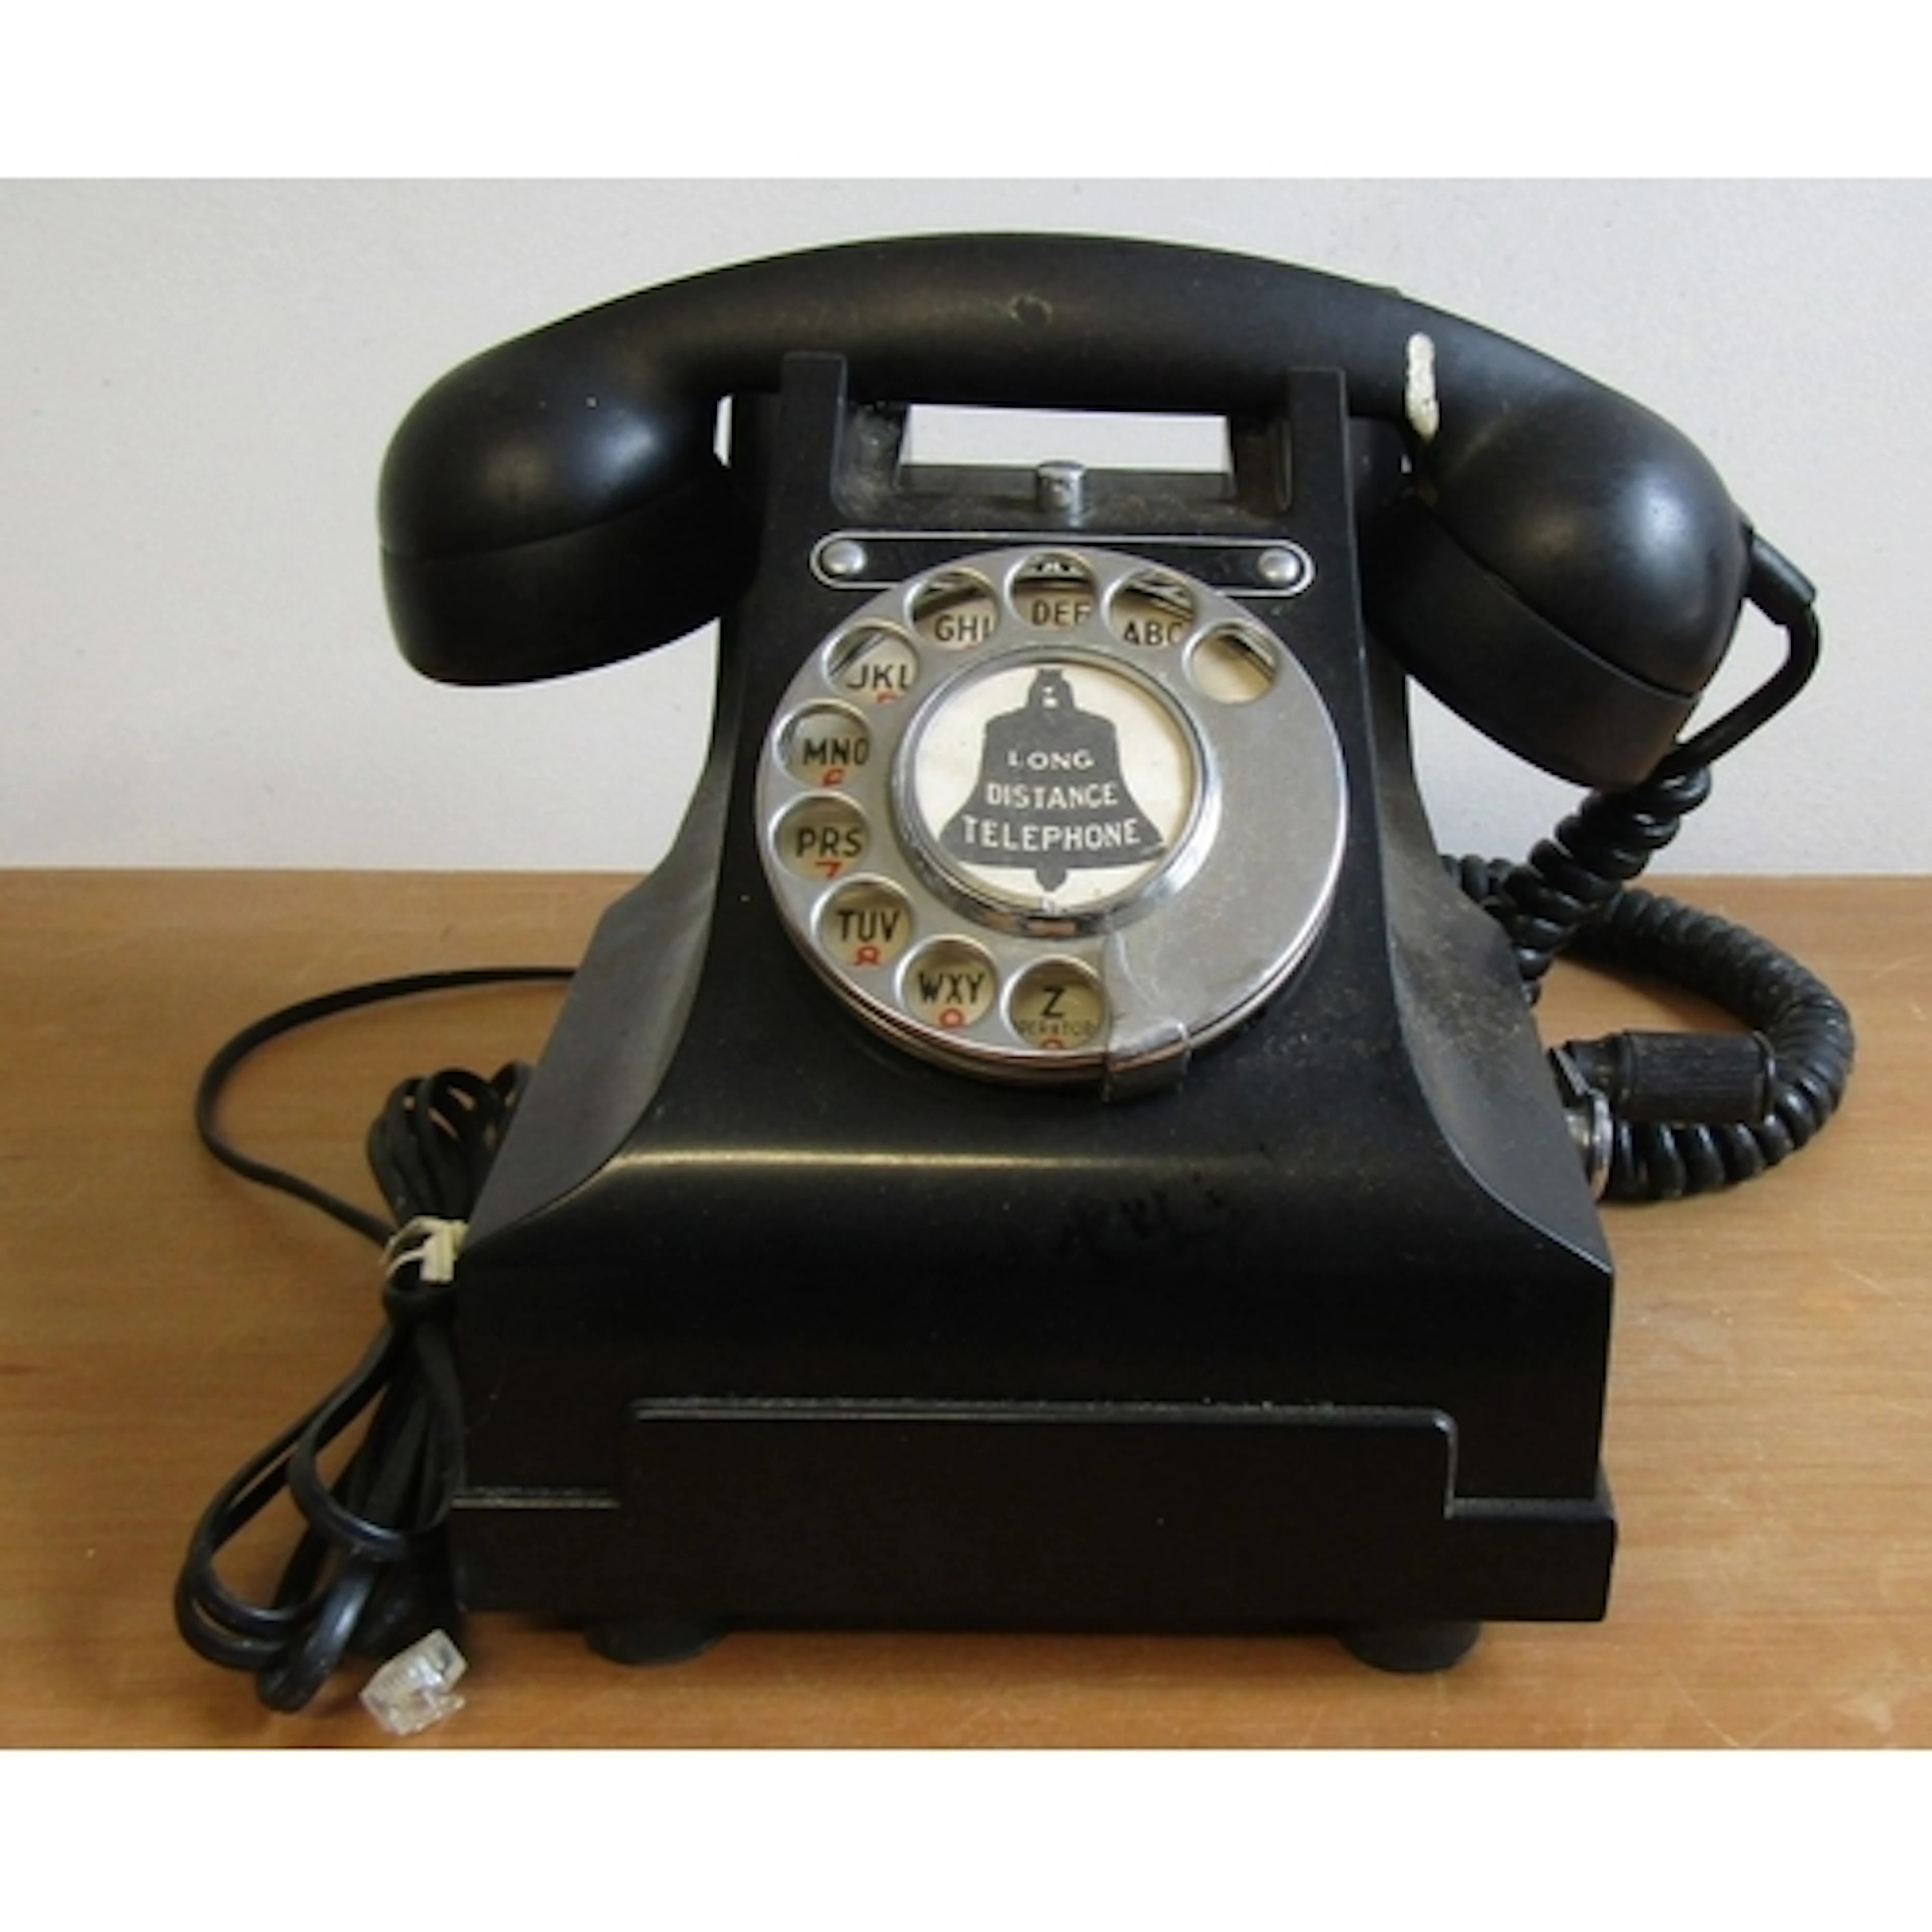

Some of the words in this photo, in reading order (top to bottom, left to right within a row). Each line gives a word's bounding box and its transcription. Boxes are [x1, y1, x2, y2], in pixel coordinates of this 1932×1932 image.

[1032, 598, 1091, 627] DEF
[935, 614, 990, 641] GHI
[1123, 619, 1183, 646] ABC
[846, 664, 912, 691] JKL
[803, 737, 869, 766] MNO
[1008, 749, 1095, 770] LONG
[986, 782, 1119, 809] DISTANCE
[796, 827, 862, 857] PRS
[962, 814, 1141, 851] TELEPHONE
[837, 910, 899, 942] TUV
[918, 972, 984, 1004] WXY
[1040, 986, 1066, 1018] Z
